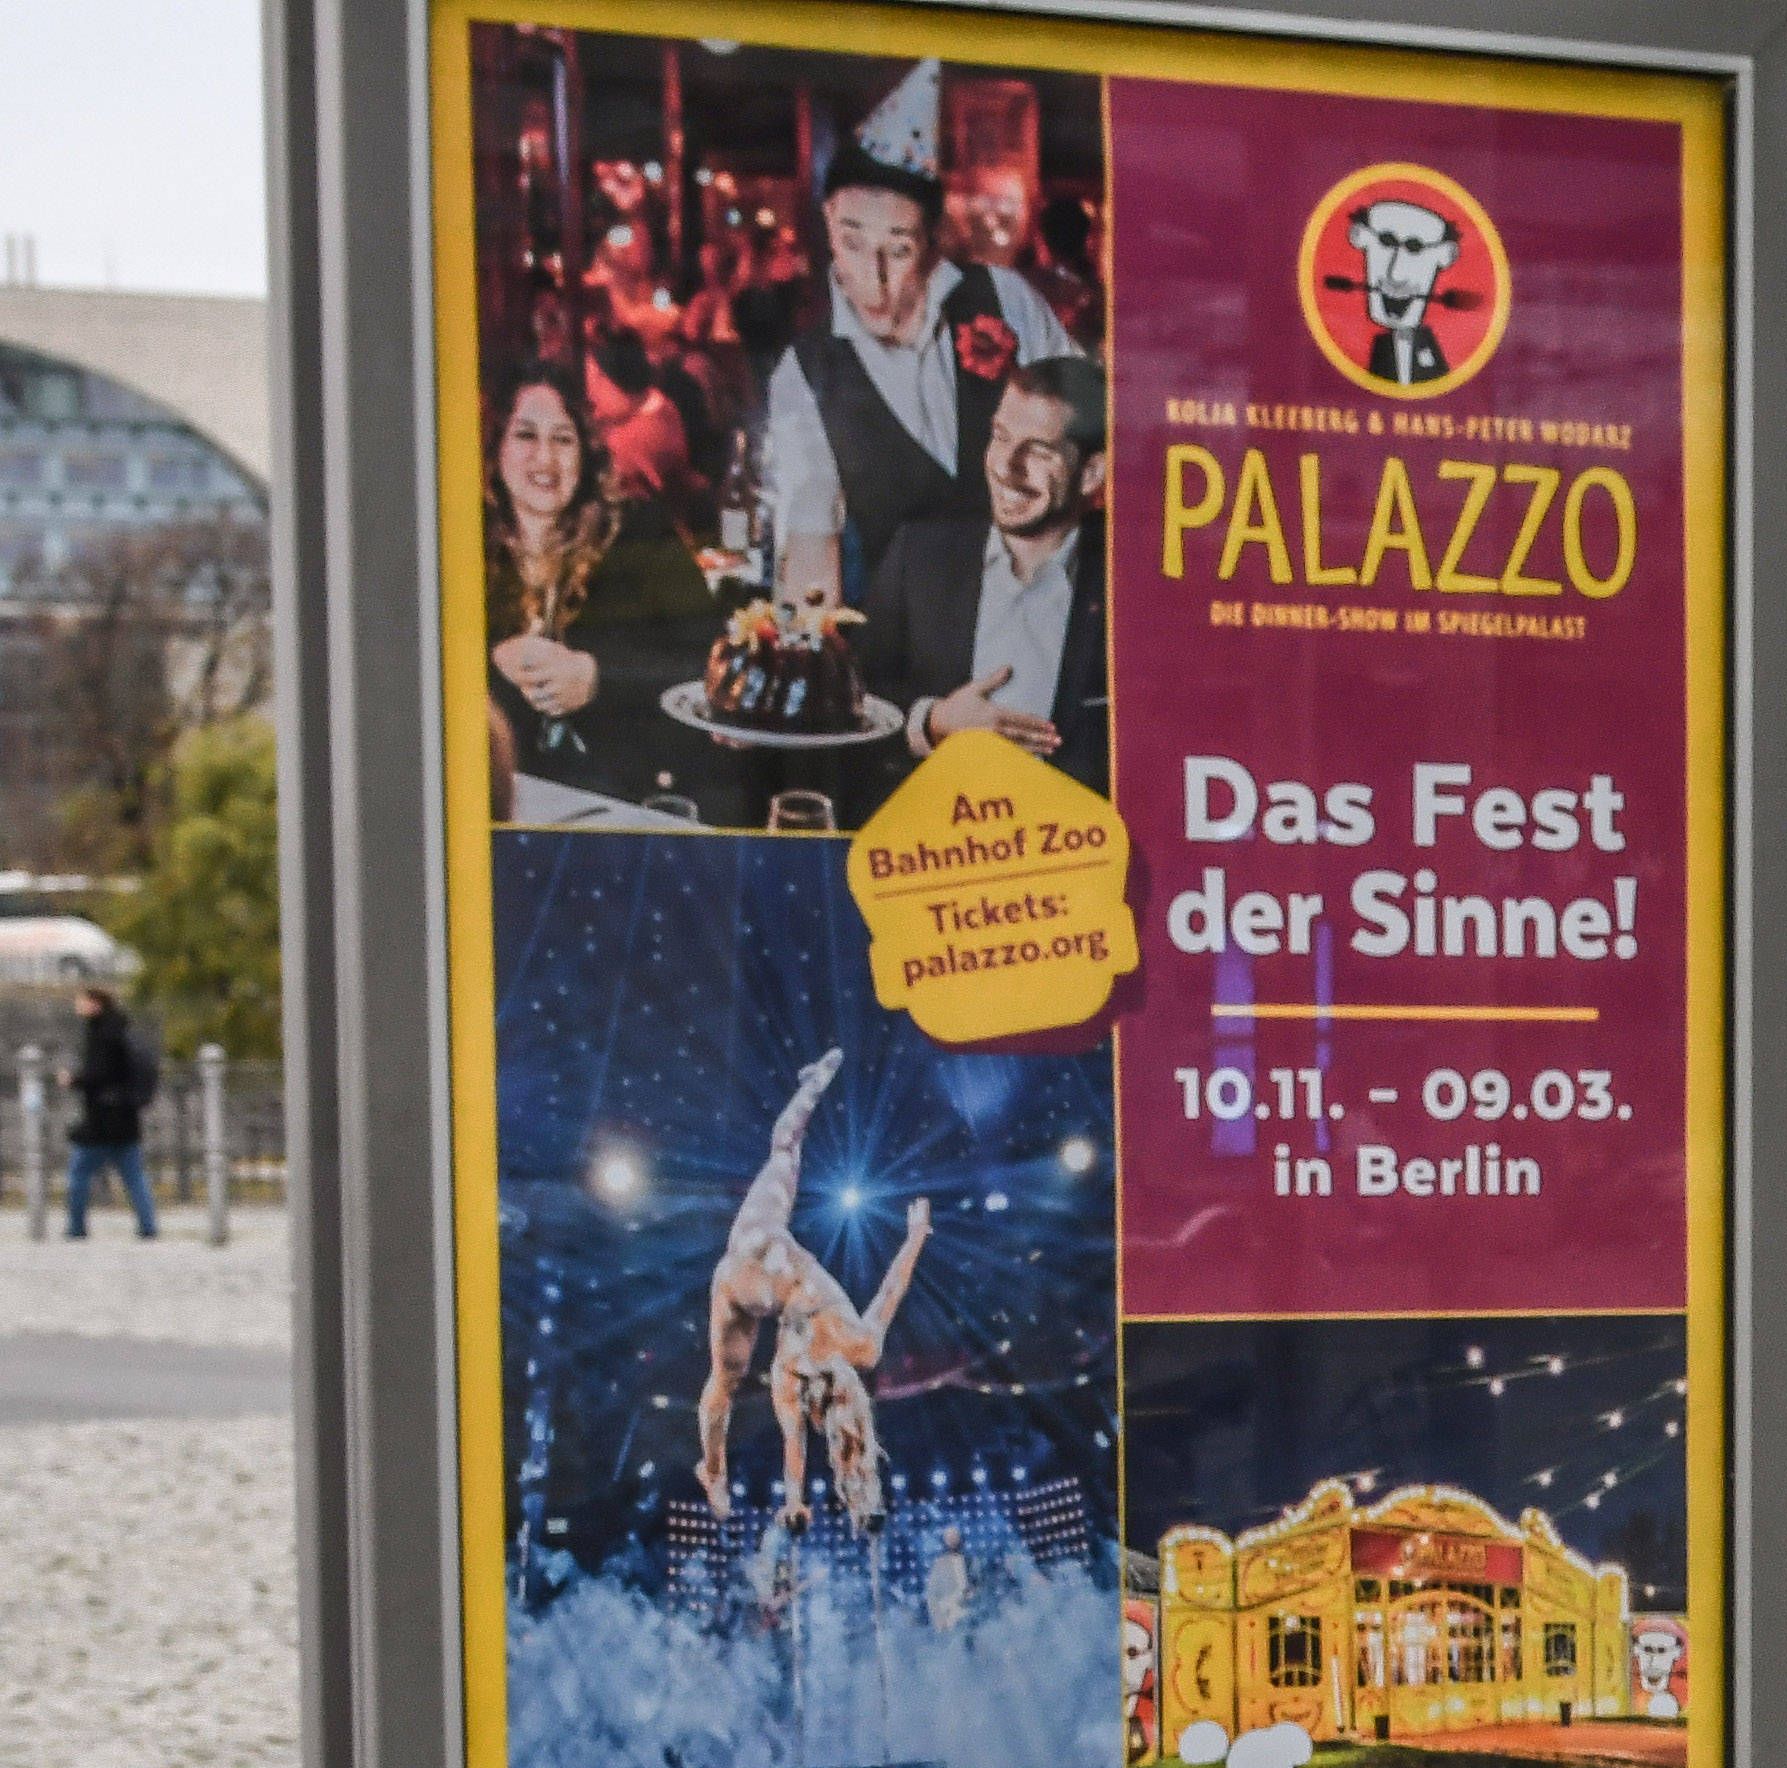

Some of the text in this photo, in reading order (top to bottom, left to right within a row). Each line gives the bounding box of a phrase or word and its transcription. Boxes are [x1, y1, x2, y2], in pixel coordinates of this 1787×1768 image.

[1162, 443, 1638, 599] PALAZZO
[1210, 600, 1245, 627] DIE
[1251, 602, 1398, 632] DINNER-SHOW
[1437, 610, 1586, 640] SPIEGELPALAST
[952, 793, 1015, 826] Am
[1184, 755, 1627, 852] Das Fest
[868, 823, 1107, 879] Bahnhof Zoo
[928, 894, 1069, 935] Tickets:
[1167, 867, 1638, 961] der Sinne!
[903, 930, 1109, 987] palazzo.org
[1174, 1067, 1345, 1121] 10.11.
[1422, 1068, 1633, 1122] 09.03.
[1273, 1142, 1542, 1198] in Berlin
